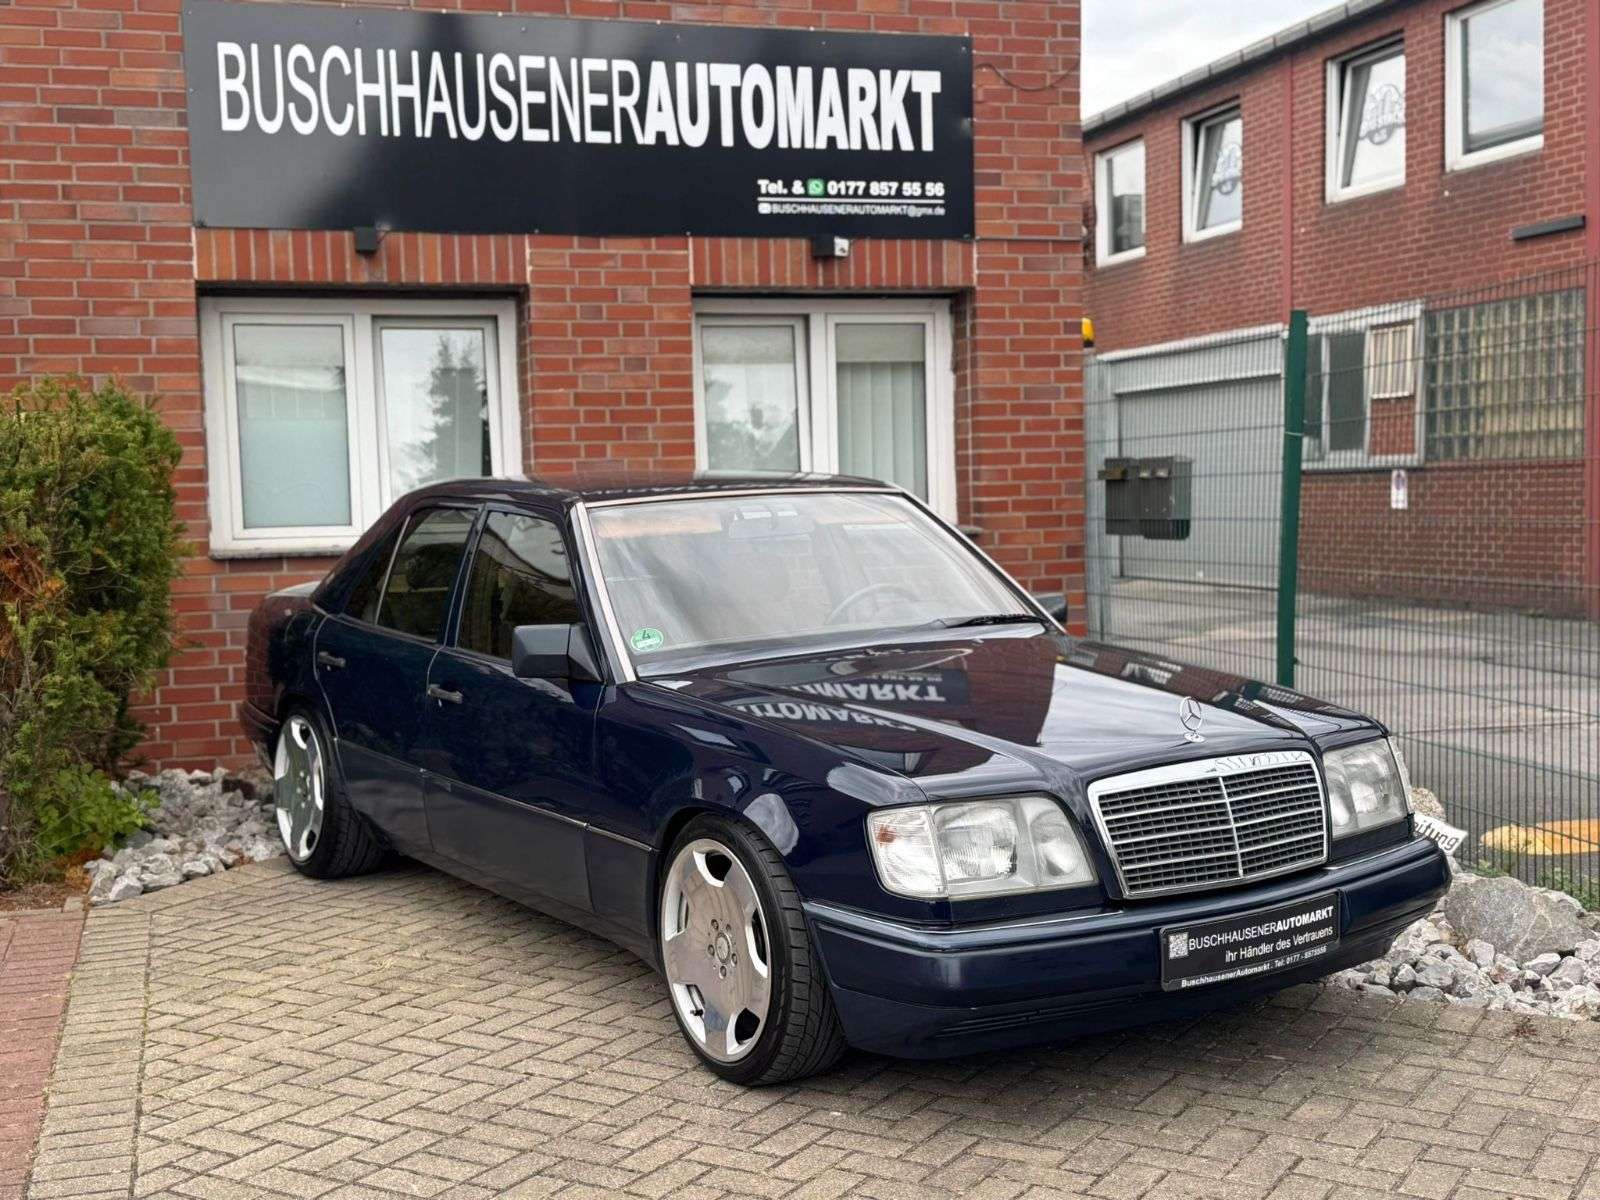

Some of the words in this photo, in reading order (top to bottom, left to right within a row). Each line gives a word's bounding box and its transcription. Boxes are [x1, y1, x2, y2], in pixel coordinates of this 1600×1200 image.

[216, 41, 942, 153] BUSCHHAUSENERAUTOMARKT
[757, 179, 788, 194] Tel.
[791, 180, 805, 195] &
[827, 180, 866, 196] 0177
[869, 181, 899, 197] 857
[902, 182, 922, 197] 55
[925, 182, 945, 197] 56
[1188, 905, 1335, 951] BUSCHHAUSENERAUTOMARKT
[1240, 942, 1275, 961] Händler
[1276, 937, 1292, 951] des
[1292, 925, 1334, 945] Vertrauens
[1181, 962, 1271, 988] BuschhausenerAutomarkt
